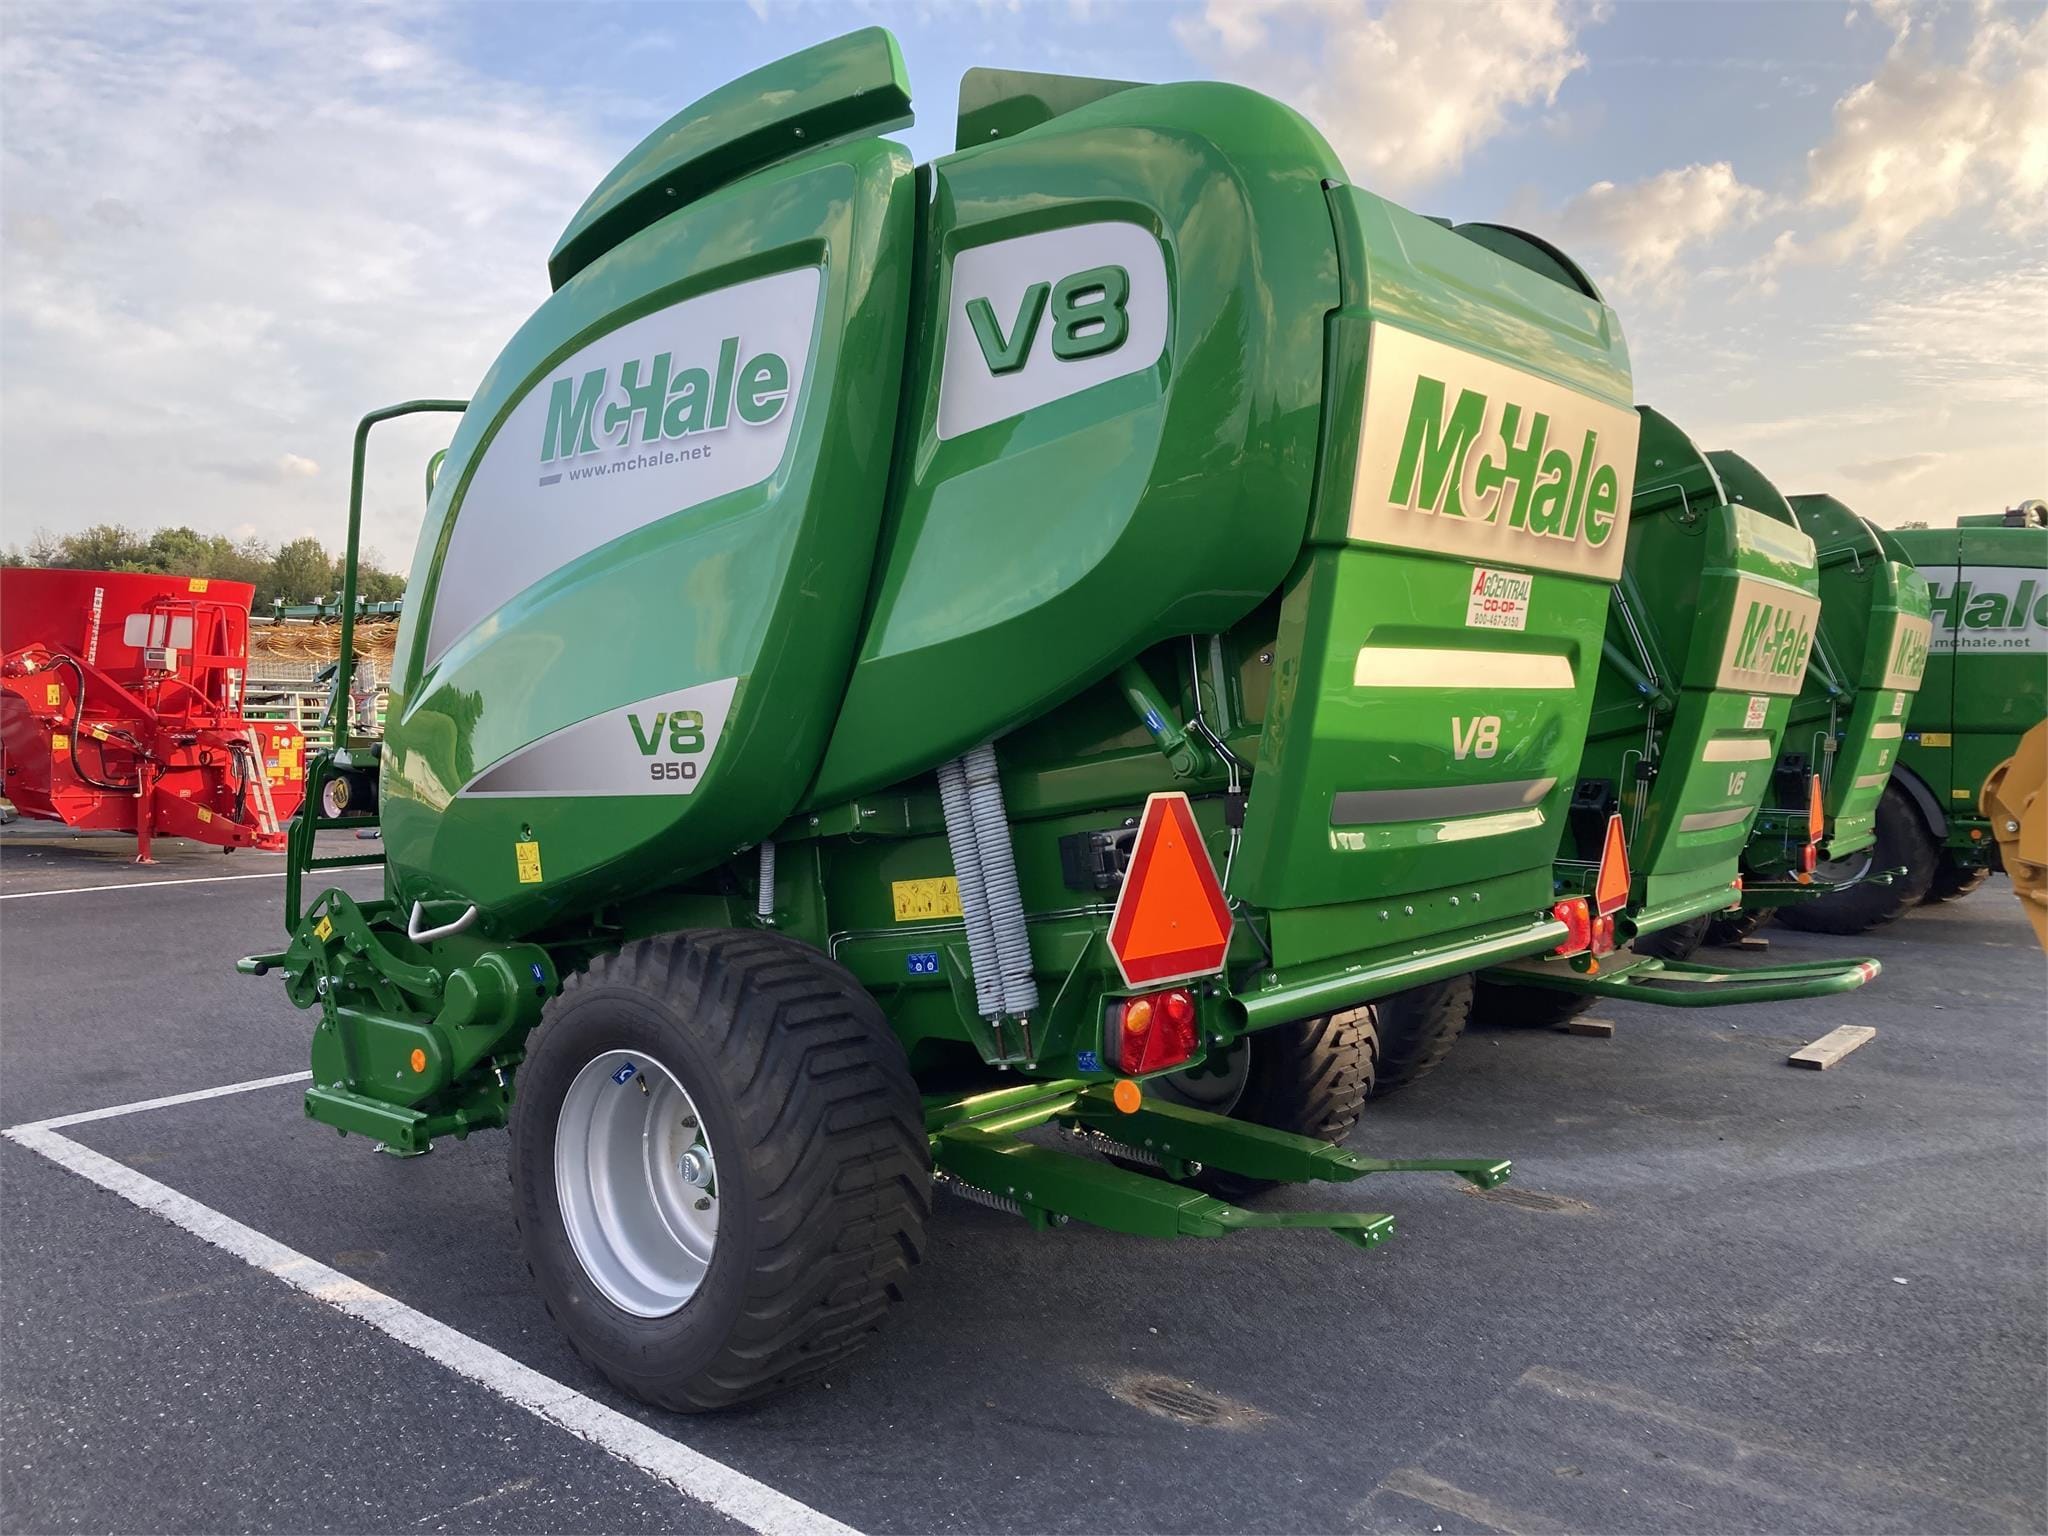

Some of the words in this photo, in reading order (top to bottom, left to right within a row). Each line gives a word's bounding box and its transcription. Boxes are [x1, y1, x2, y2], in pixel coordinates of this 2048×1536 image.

[965, 265, 1130, 378] V8
[539, 336, 790, 463] McHale
[569, 444, 712, 481] www.mchale.net
[1388, 374, 1619, 546] McHale
[1733, 601, 1809, 676] McHale
[627, 710, 705, 755] V8
[1451, 715, 1501, 760] V8
[650, 761, 697, 780] 950
